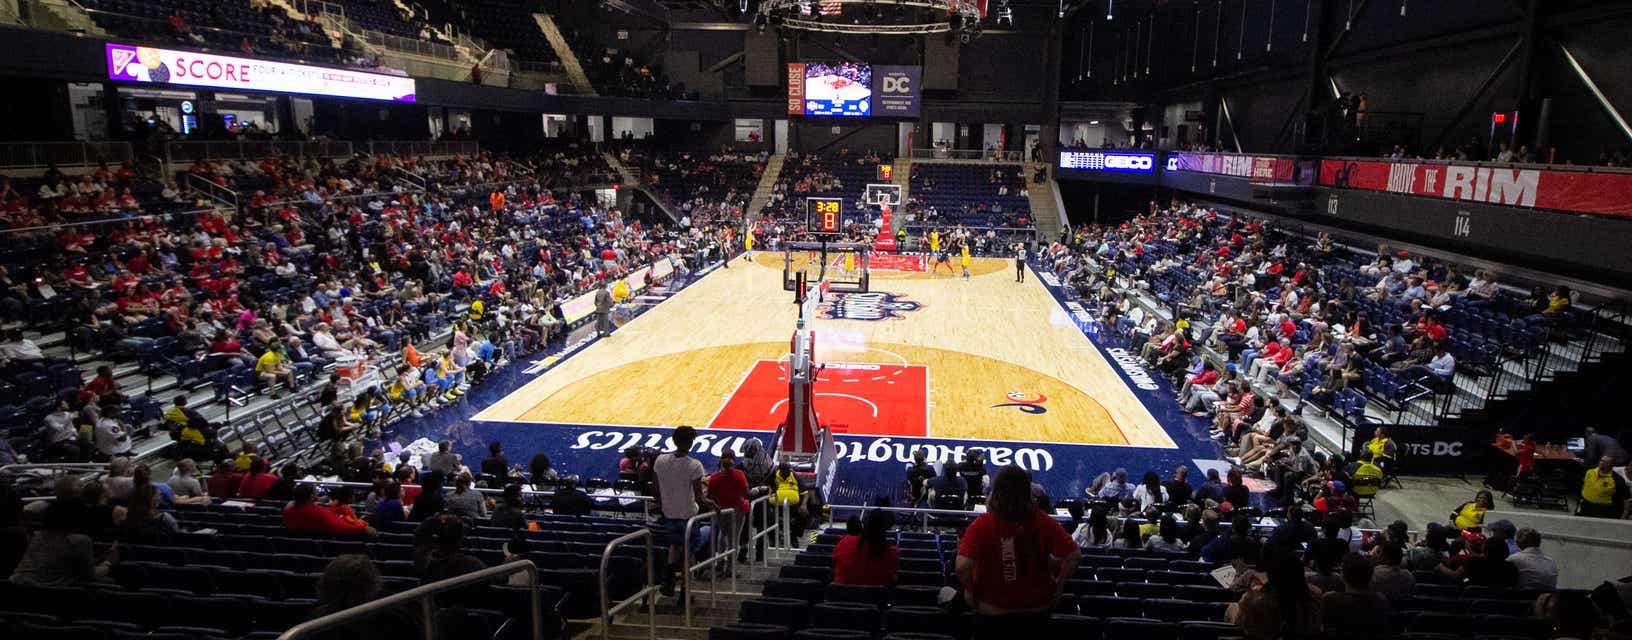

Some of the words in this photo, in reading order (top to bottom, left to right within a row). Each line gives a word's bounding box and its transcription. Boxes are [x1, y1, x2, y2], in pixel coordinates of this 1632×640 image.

[175, 58, 251, 83] SCORE
[788, 67, 801, 97] CLOSE
[883, 76, 910, 93] DC
[788, 100, 801, 111] SO
[1104, 156, 1152, 170] GEICO
[1221, 155, 1253, 177] RIM
[1386, 162, 1419, 194] ABOVE
[1424, 168, 1438, 193] THE
[1443, 165, 1540, 208] RIM
[817, 202, 839, 213] 3:28
[824, 212, 836, 229] 8
[1454, 215, 1470, 237] 114
[1433, 441, 1463, 457] DC
